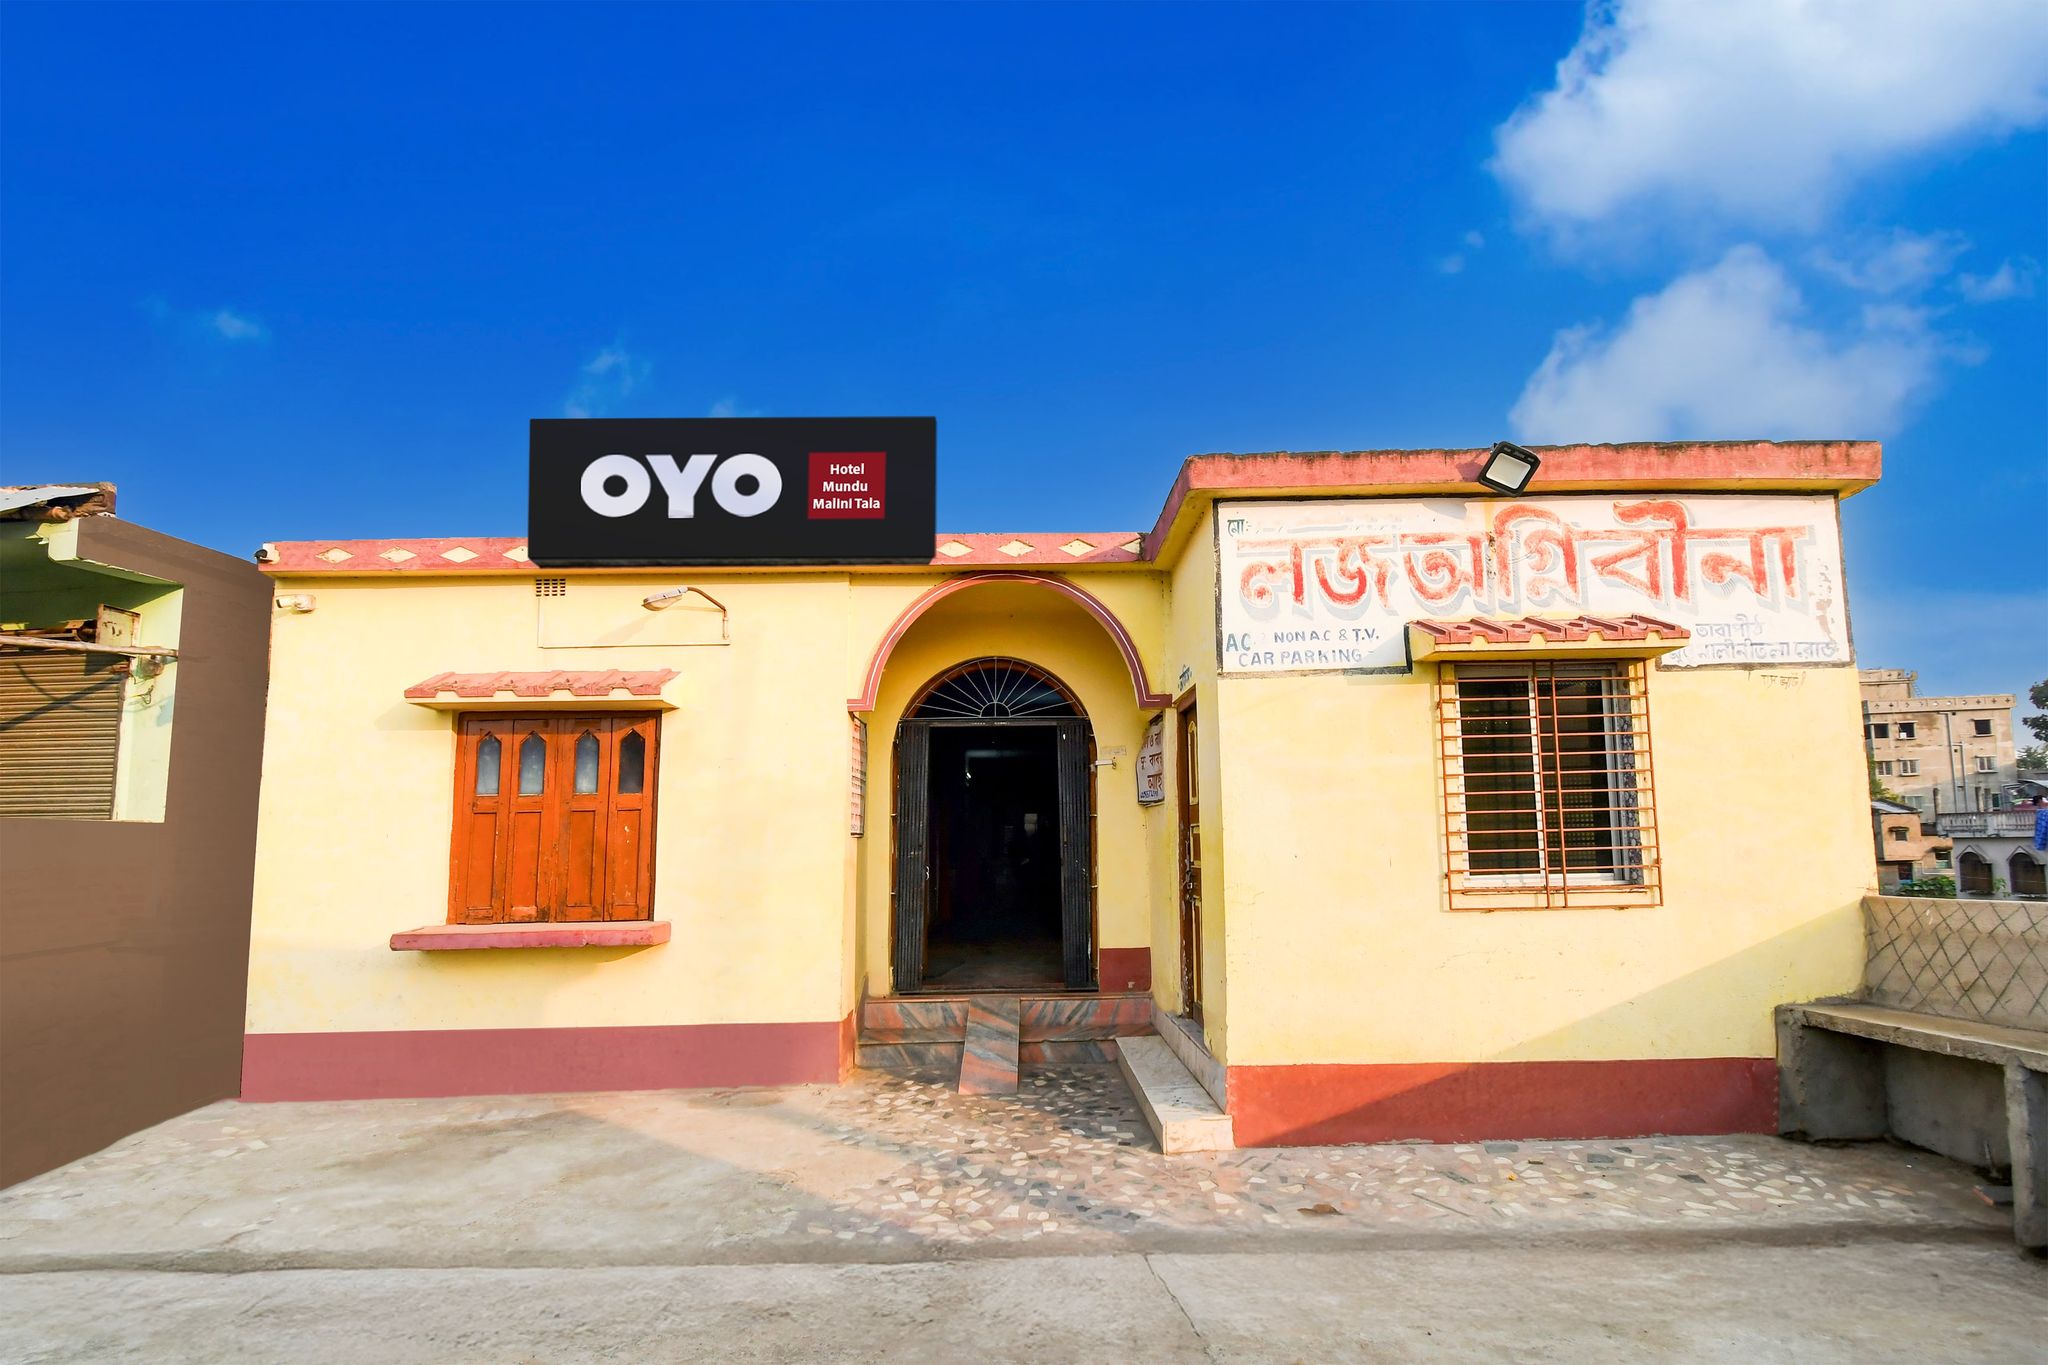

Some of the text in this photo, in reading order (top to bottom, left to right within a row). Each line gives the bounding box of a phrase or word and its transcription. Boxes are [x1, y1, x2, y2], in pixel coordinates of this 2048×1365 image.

[829, 463, 865, 475] Hotel
[580, 453, 782, 518] OYO
[823, 480, 868, 492] Mundu
[813, 497, 880, 509] Malini Tala
[1236, 535, 1394, 612] লজ
[1239, 652, 1274, 668] CAR
